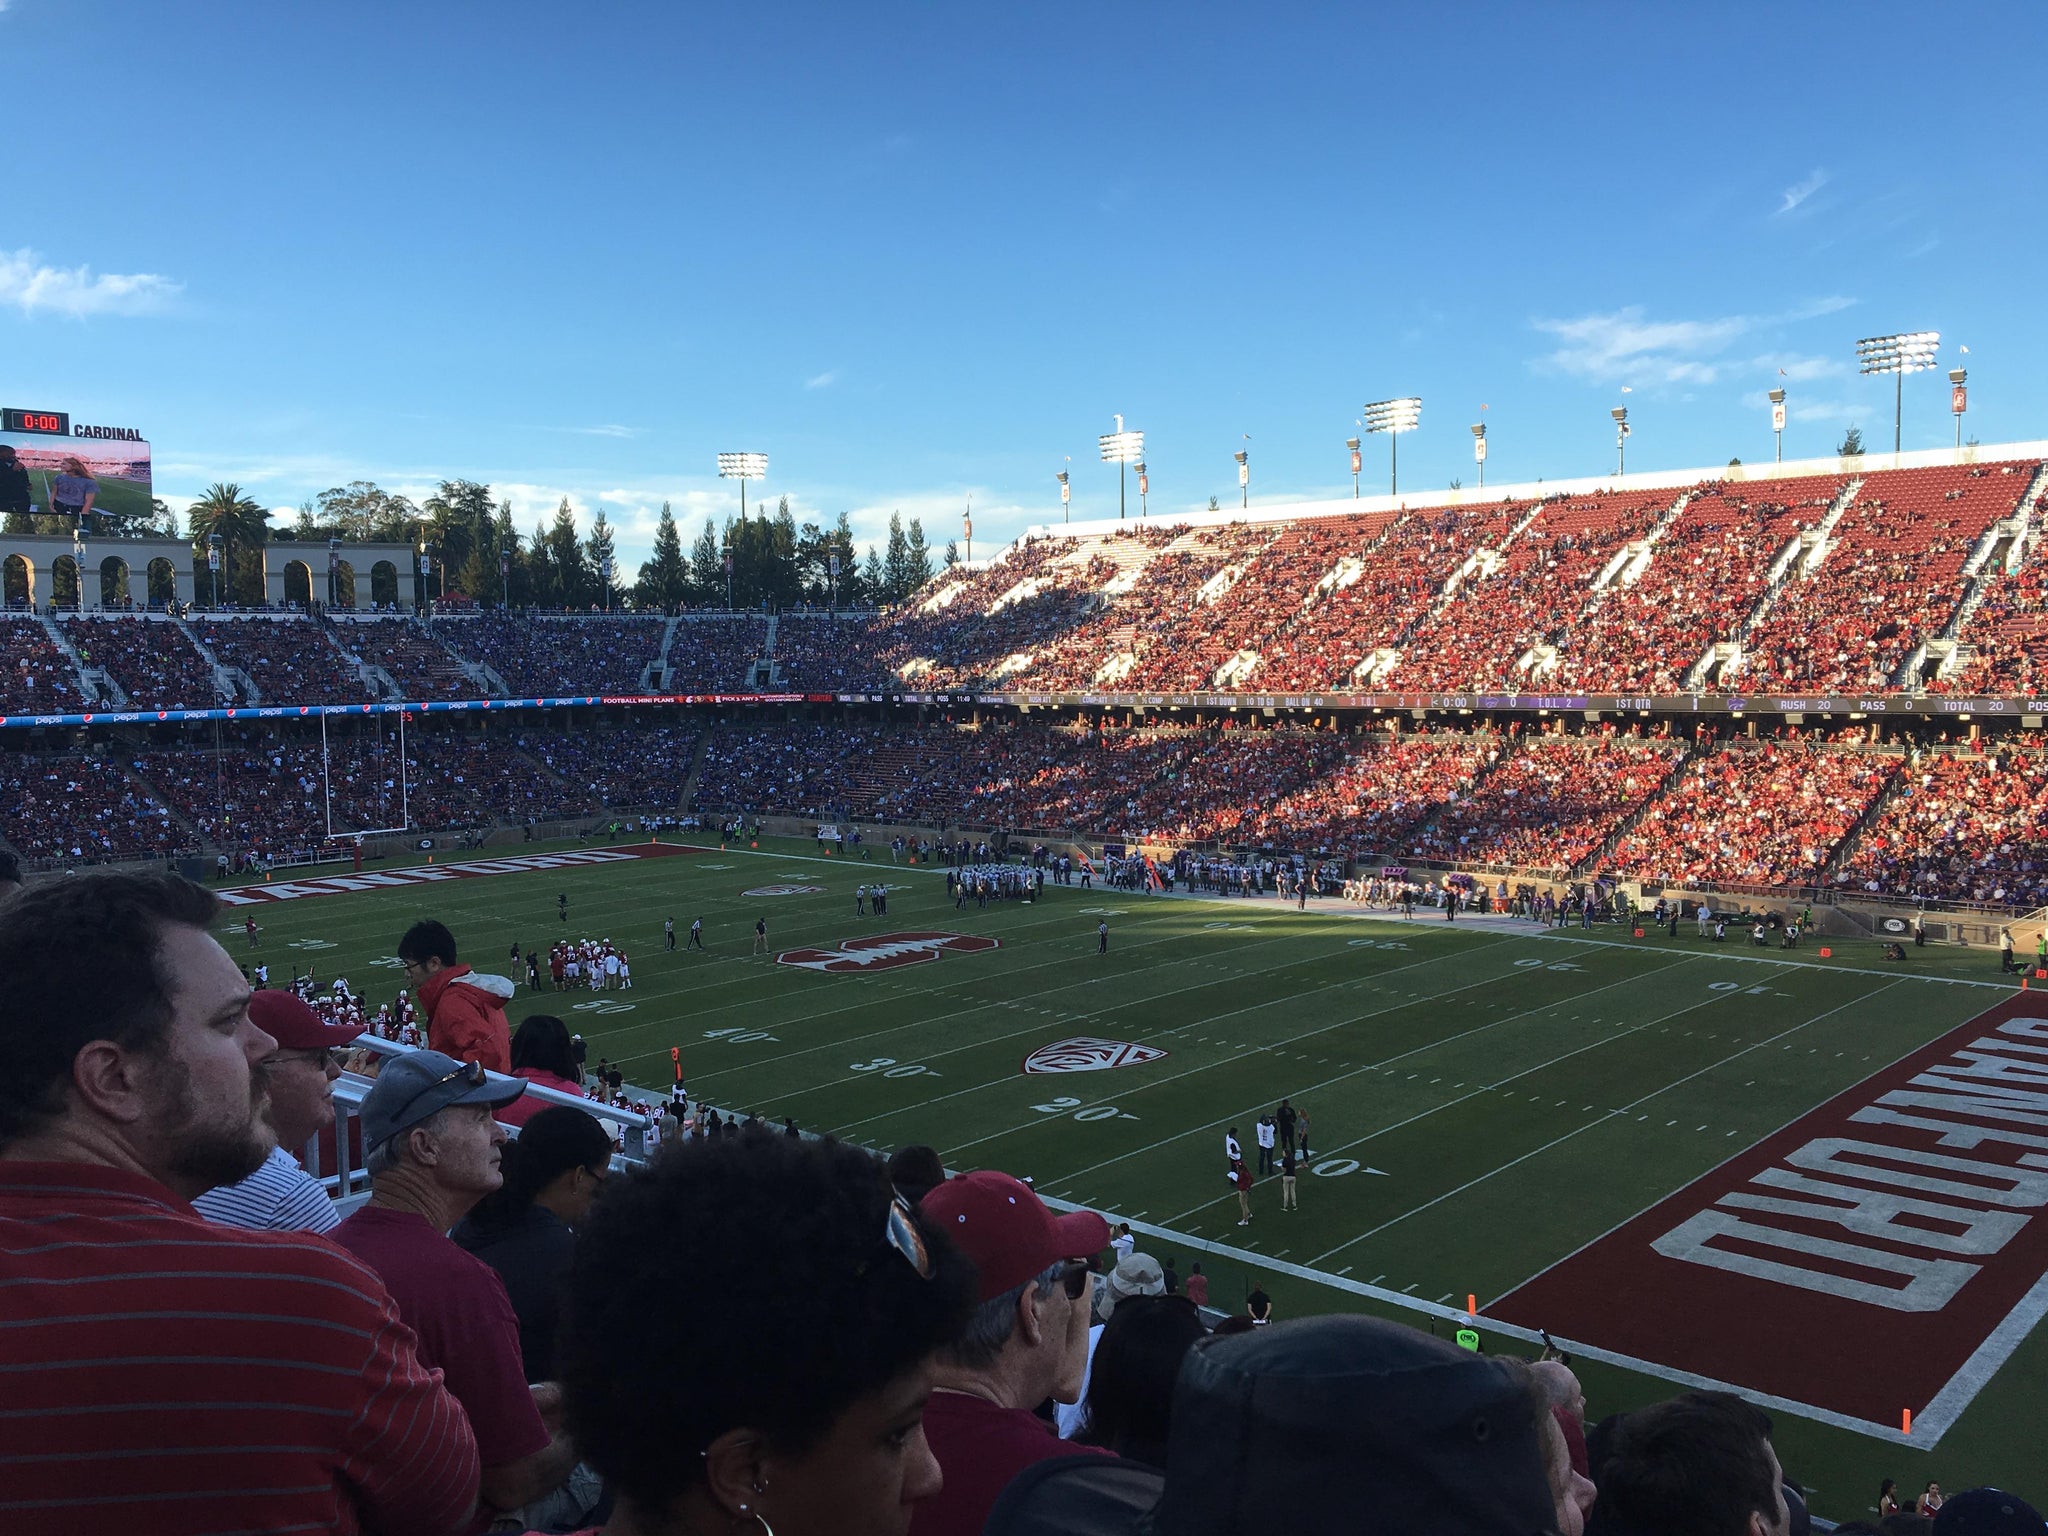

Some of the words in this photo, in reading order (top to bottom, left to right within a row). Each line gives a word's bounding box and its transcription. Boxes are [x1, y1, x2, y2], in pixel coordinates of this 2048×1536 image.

[24, 414, 58, 430] 0:00
[74, 424, 143, 441] CARDINAL
[448, 702, 468, 710] pepsi
[1219, 697, 1237, 706] DOWN
[1246, 697, 1254, 706] 10
[1257, 697, 1265, 706] TO
[1266, 697, 1275, 706] GO
[1285, 697, 1300, 706] BALL
[1301, 697, 1311, 706] ON
[1313, 698, 1323, 706] 40
[1350, 698, 1356, 706] 3
[1360, 697, 1379, 706] T.O.L.
[1398, 698, 1405, 706] 3
[1443, 698, 1467, 708] 0:00
[1510, 698, 1517, 708] 0
[1537, 699, 1560, 708] T.O.L.
[1566, 699, 1572, 708] 2
[1615, 699, 1632, 708] 1ST
[1635, 699, 1651, 709] QTR
[1781, 701, 1806, 710] RUSH
[1817, 701, 1831, 710] 20
[1860, 701, 1886, 710] PASS
[1905, 701, 1913, 709] 0
[1944, 701, 1975, 711] TOTAL
[1988, 702, 2004, 711] 20
[259, 708, 282, 717] pepsi
[325, 705, 347, 715] pepsi
[384, 703, 406, 712] pepi
[35, 715, 62, 725] pepsi
[113, 713, 139, 722] pepsi
[184, 710, 208, 720] pepsi
[216, 851, 640, 905] TANFORD
[572, 999, 637, 1015] 50
[702, 1027, 769, 1044] 40
[849, 1058, 927, 1078] 30
[1029, 1097, 1119, 1121] 20
[1650, 1017, 2048, 1313] ANFORD
